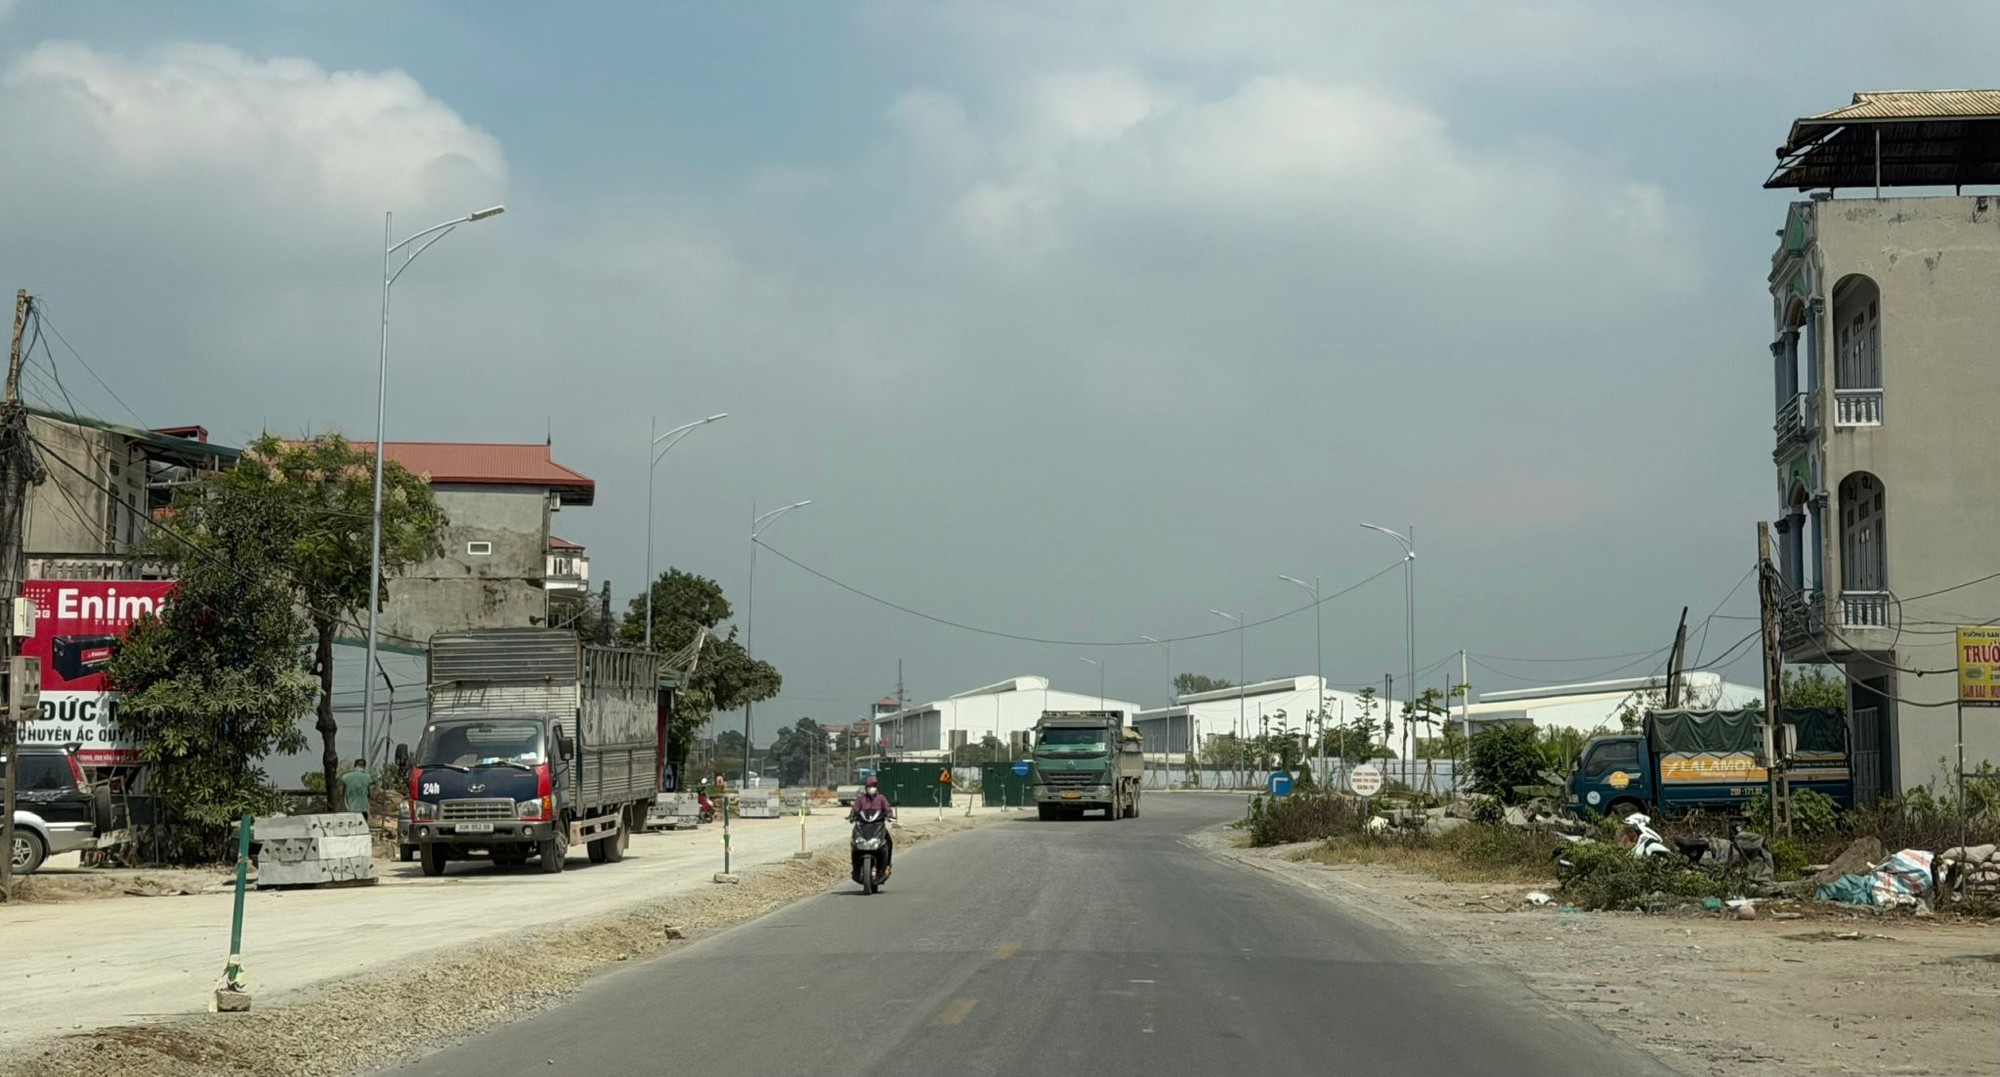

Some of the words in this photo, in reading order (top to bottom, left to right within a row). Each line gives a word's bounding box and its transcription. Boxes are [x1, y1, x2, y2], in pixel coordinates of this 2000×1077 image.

[39, 695, 97, 722] ĐỨC
[18, 726, 71, 742] CHUYÊN
[1680, 759, 1768, 772] LALAMOV
[423, 782, 440, 796] 24h
